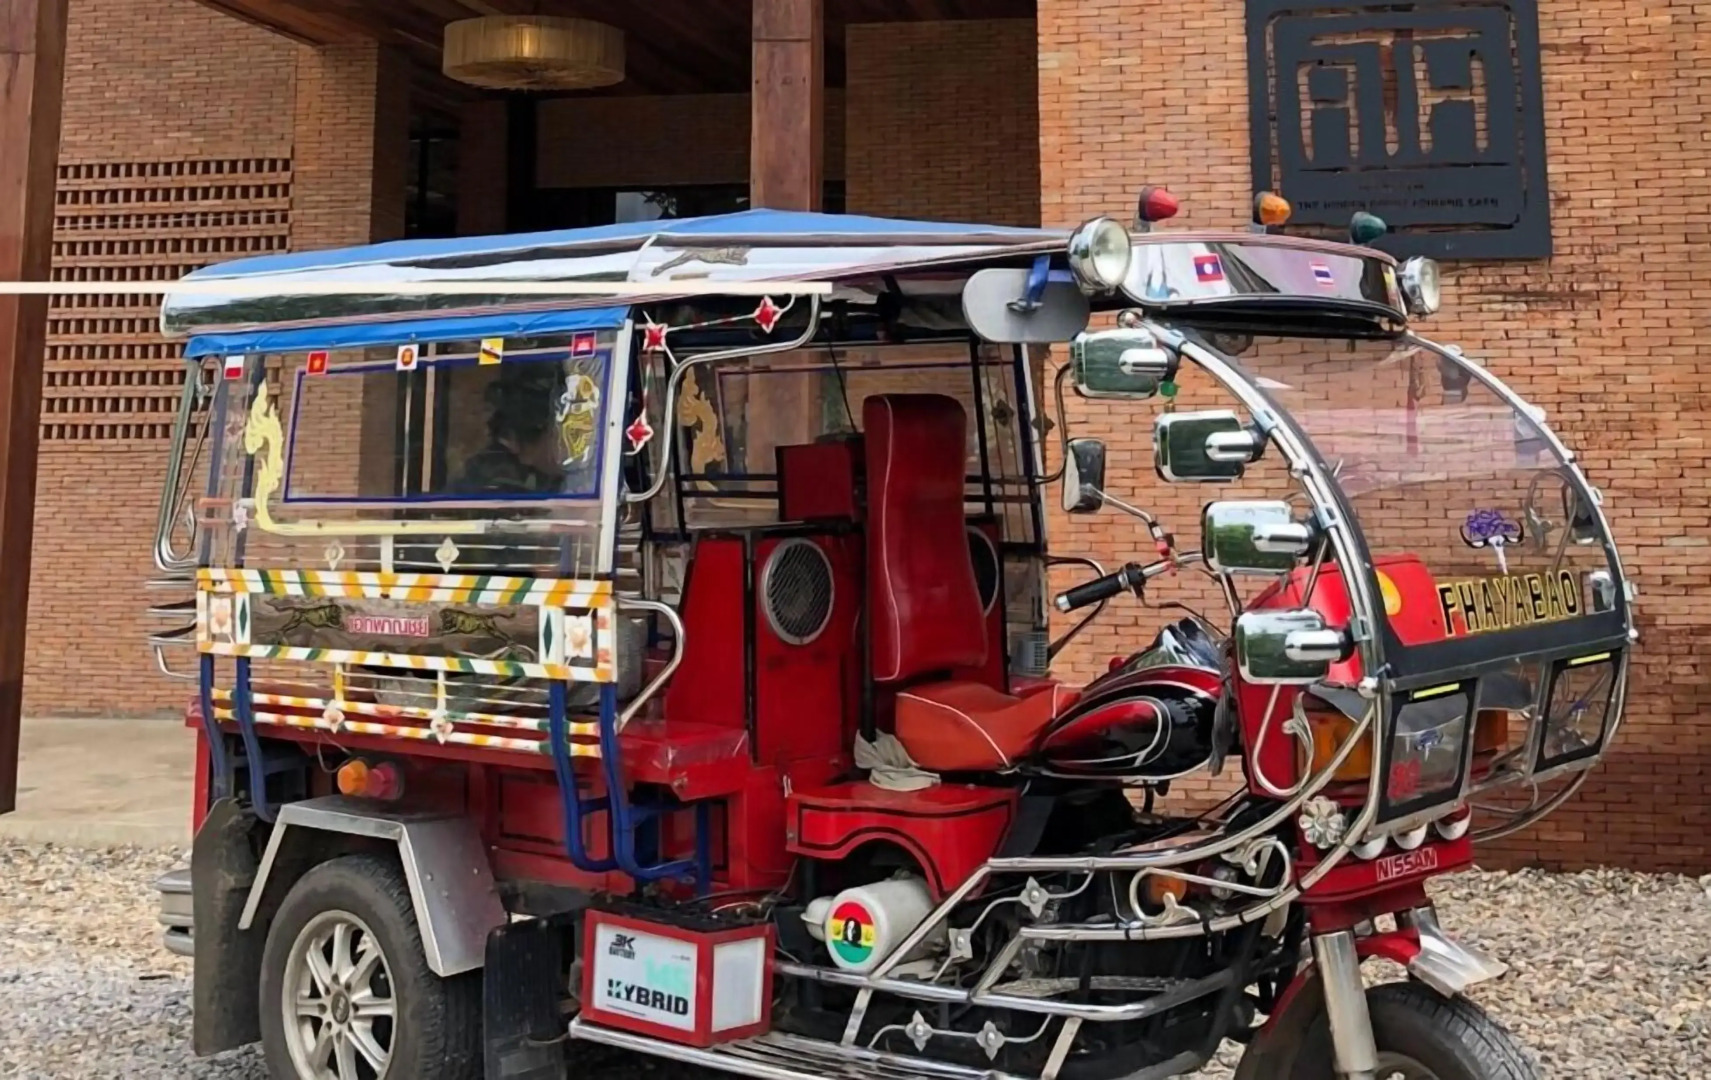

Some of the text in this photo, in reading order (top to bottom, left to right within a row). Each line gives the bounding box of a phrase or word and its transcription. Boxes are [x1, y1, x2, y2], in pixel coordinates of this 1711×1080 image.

[1296, 28, 1489, 161] ATH
[1376, 847, 1437, 881] NISSAN
[610, 934, 636, 950] 3K
[607, 978, 689, 1016] HYBRID
